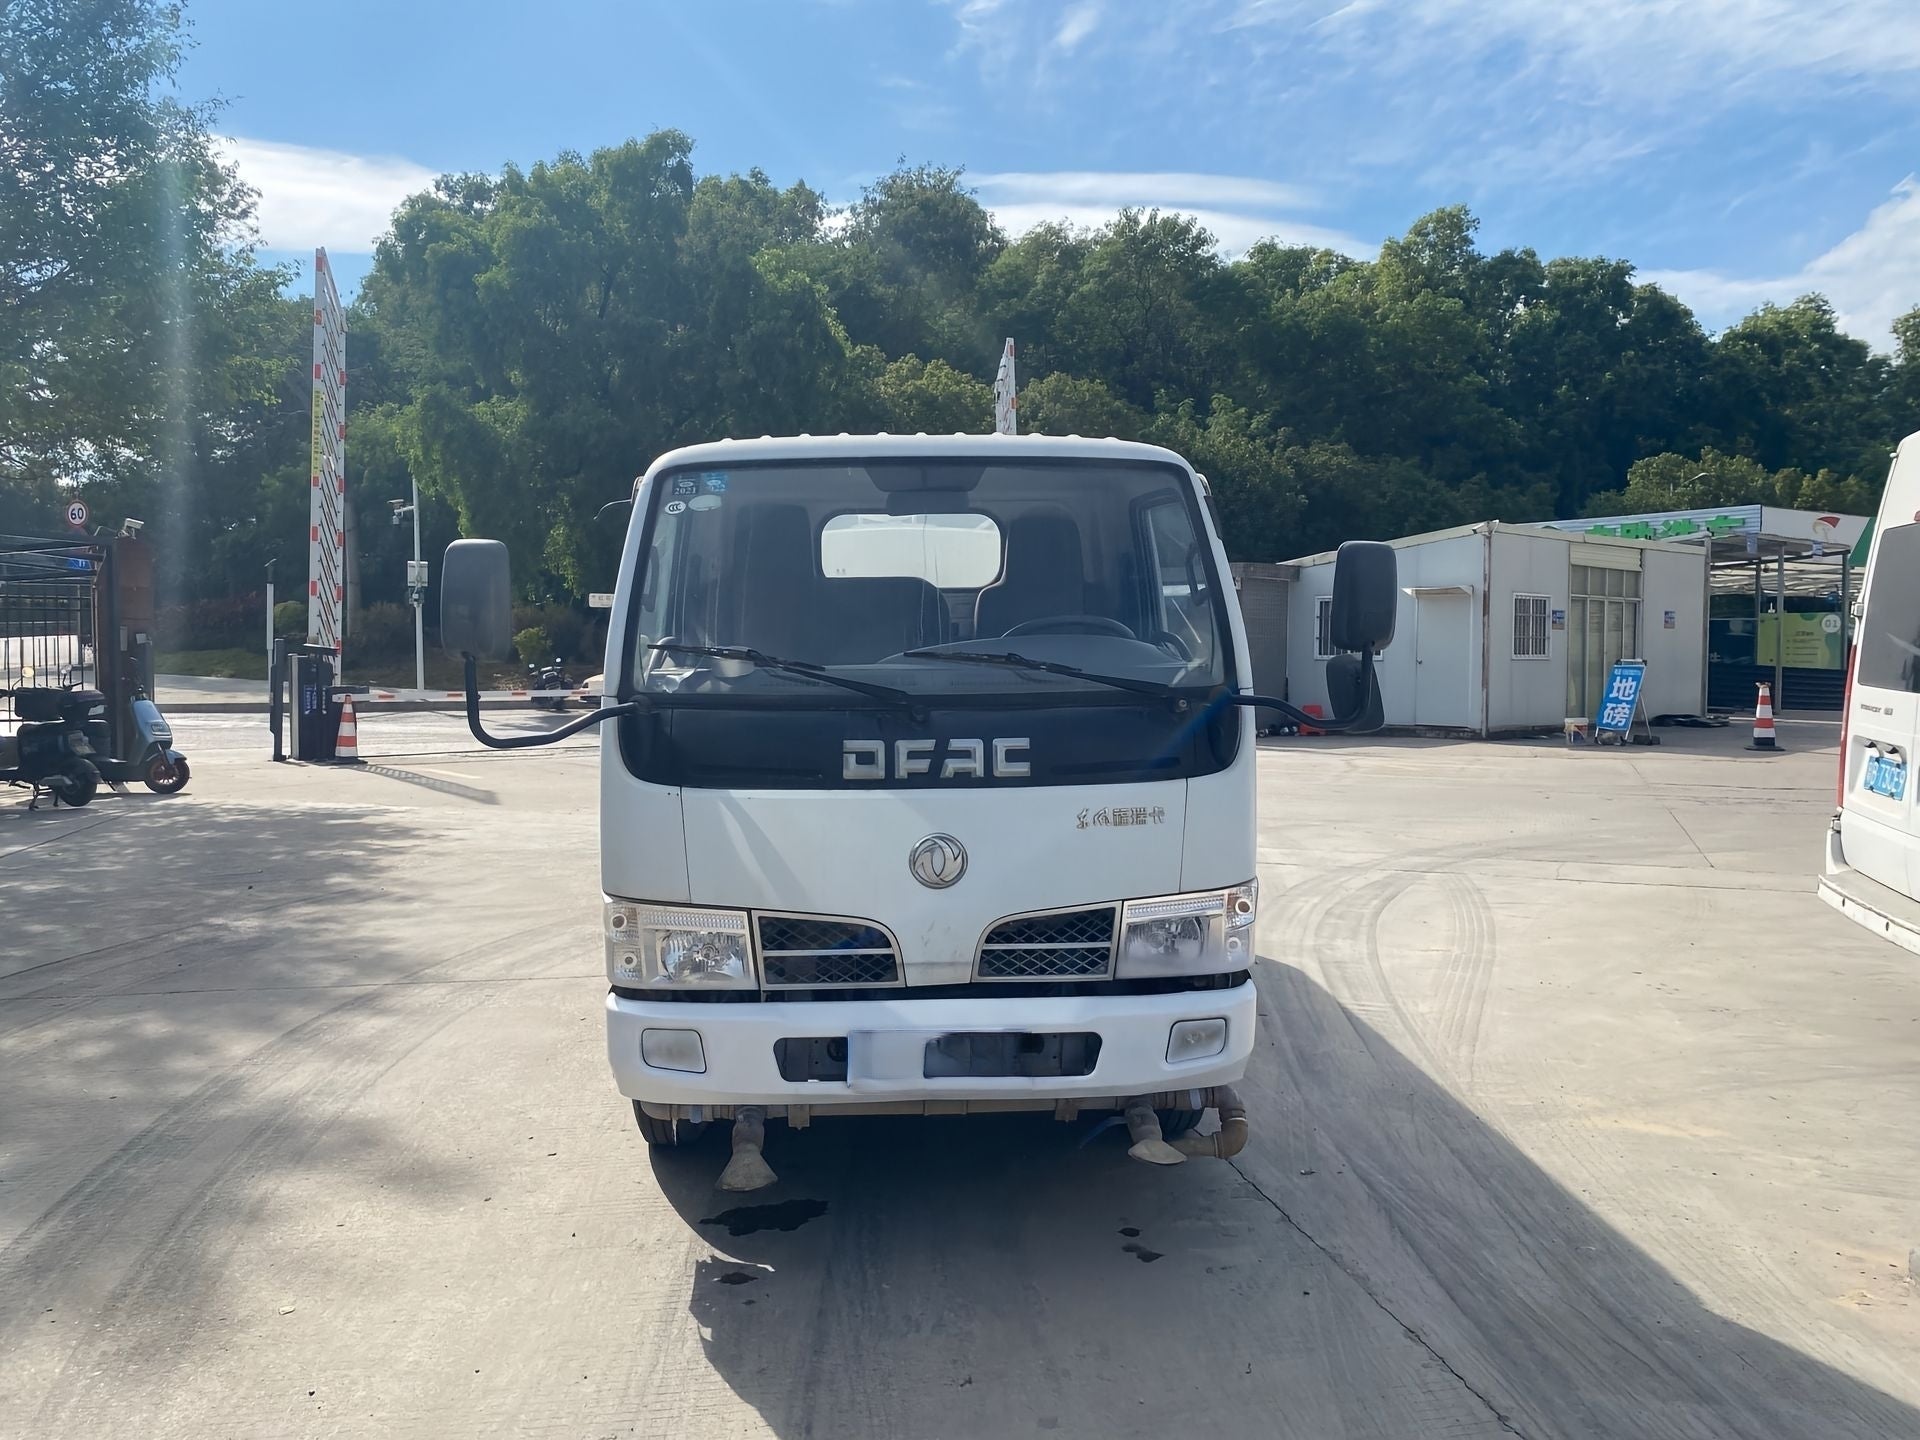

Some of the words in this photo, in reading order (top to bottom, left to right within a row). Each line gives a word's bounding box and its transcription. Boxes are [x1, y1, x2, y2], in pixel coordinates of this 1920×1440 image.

[674, 487, 696, 495] 2021
[70, 508, 84, 520] 60
[1603, 676, 1637, 726] 地磅
[843, 737, 1031, 780] DFAC
